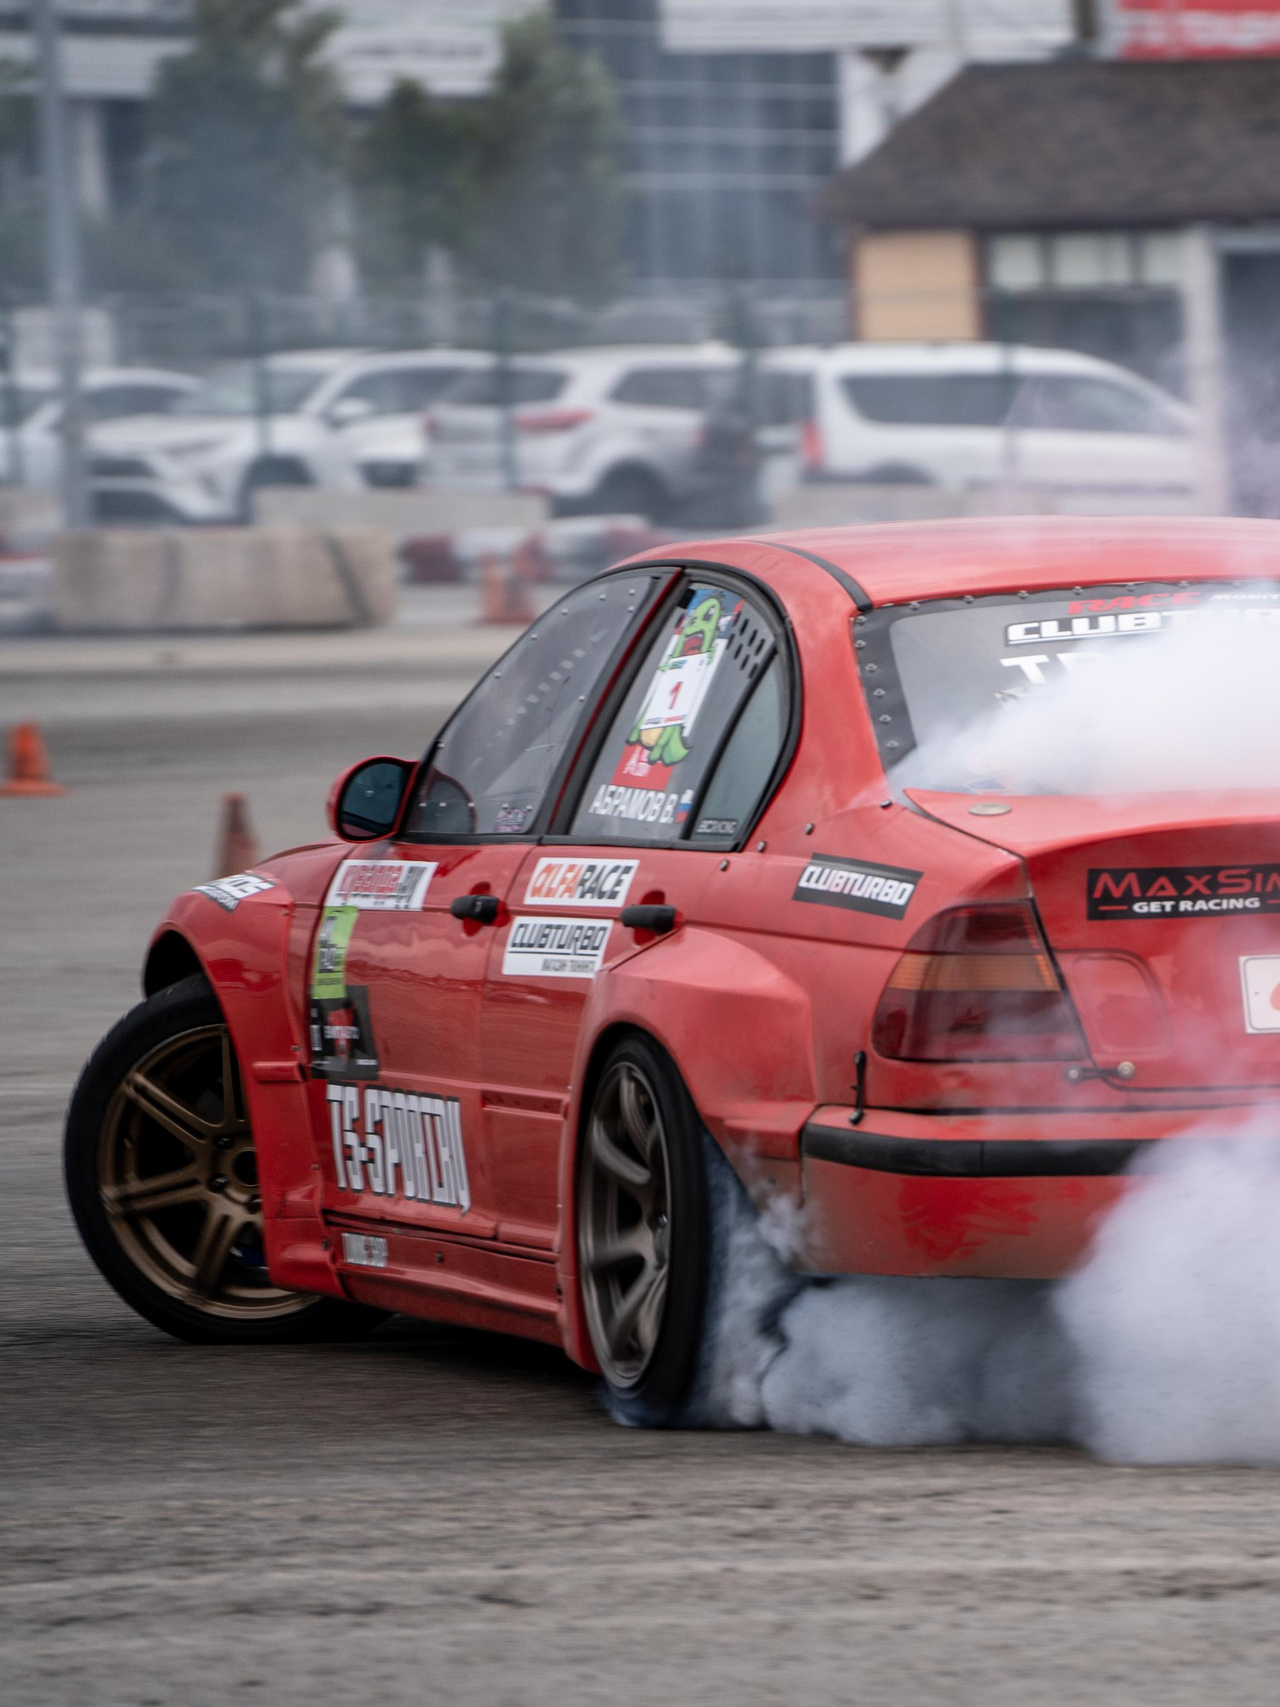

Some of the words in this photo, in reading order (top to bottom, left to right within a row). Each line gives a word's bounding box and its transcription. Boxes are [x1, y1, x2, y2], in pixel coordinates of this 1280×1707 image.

[1067, 592, 1201, 615] RACE
[668, 680, 684, 710] 1
[798, 865, 915, 906] CLUBTURBO
[1132, 900, 1176, 913] GET
[1178, 897, 1261, 912] RACING
[511, 923, 610, 954] CLUBTURBO
